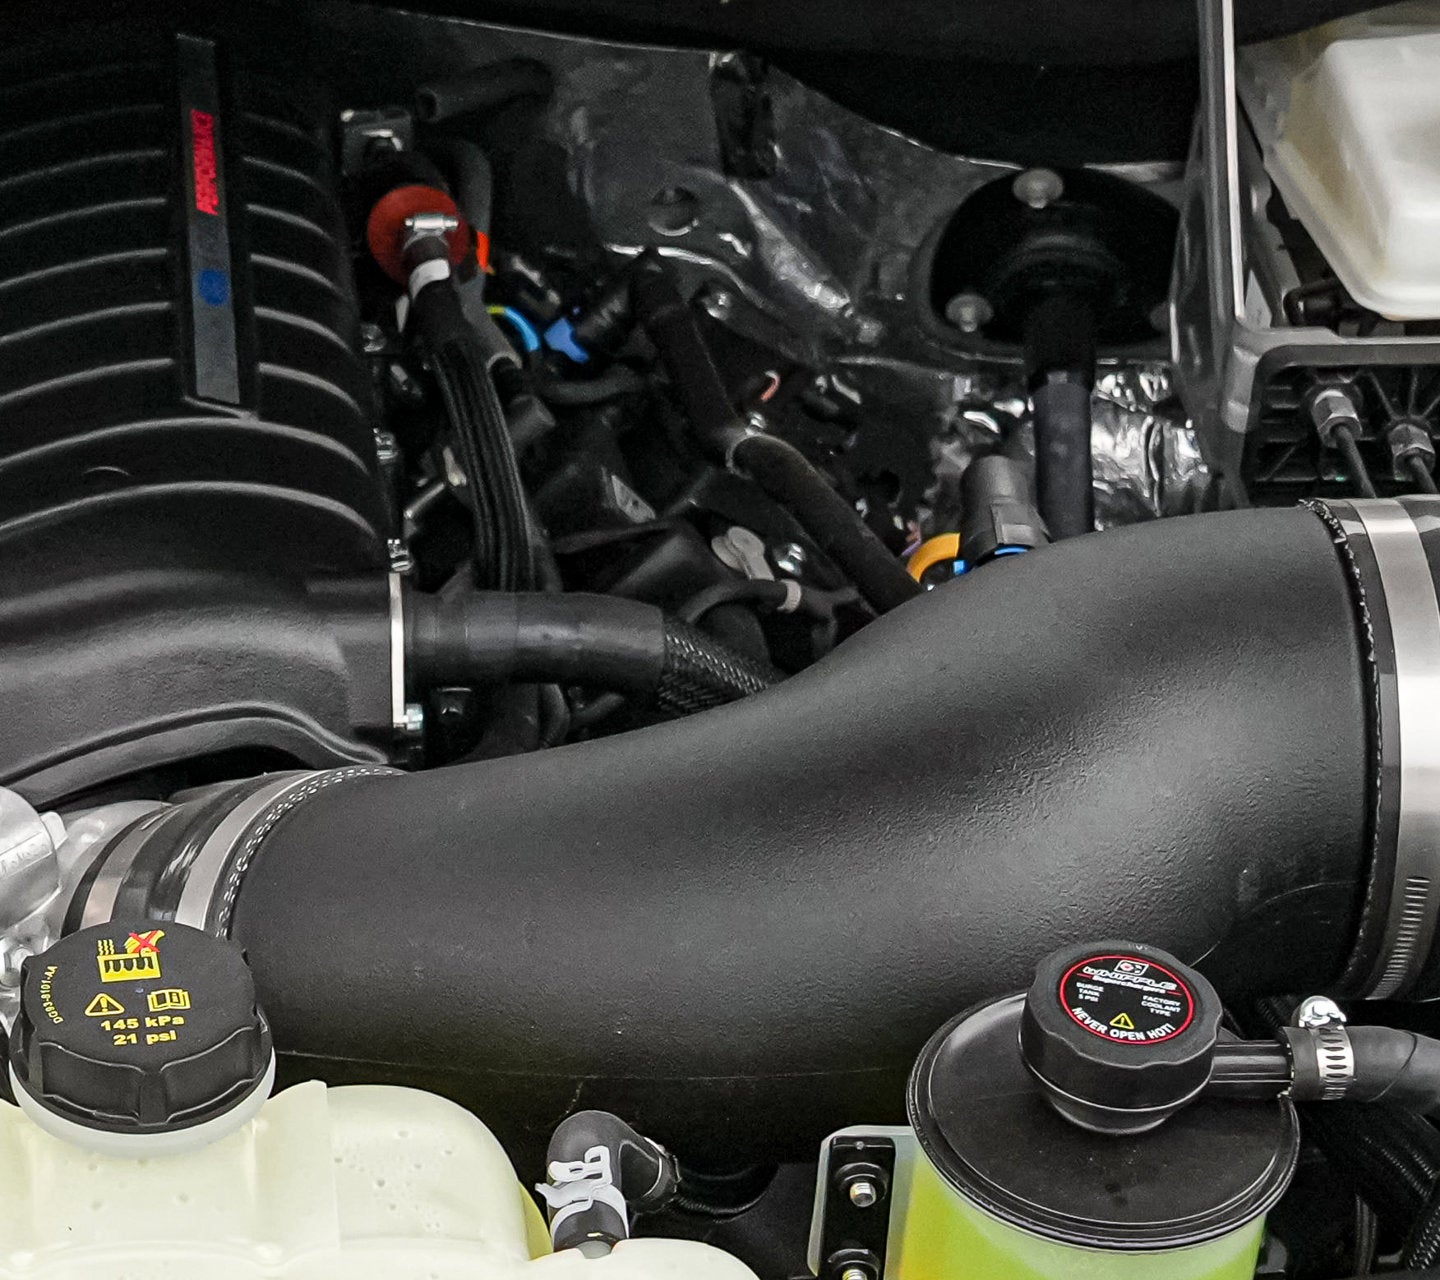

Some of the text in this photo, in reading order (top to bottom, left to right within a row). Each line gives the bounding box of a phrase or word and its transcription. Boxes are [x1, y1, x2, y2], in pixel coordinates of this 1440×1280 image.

[1076, 982, 1104, 992] SURGE
[1078, 988, 1100, 997] TANK
[1141, 1001, 1181, 1012] COOLANT
[1142, 995, 1181, 1007] FACTORY
[1150, 1008, 1171, 1017] TYPE
[101, 1016, 184, 1030] 145 kPa
[1071, 1006, 1176, 1040] NEVER OPEN HOT!
[113, 1030, 176, 1045] 21 psi
